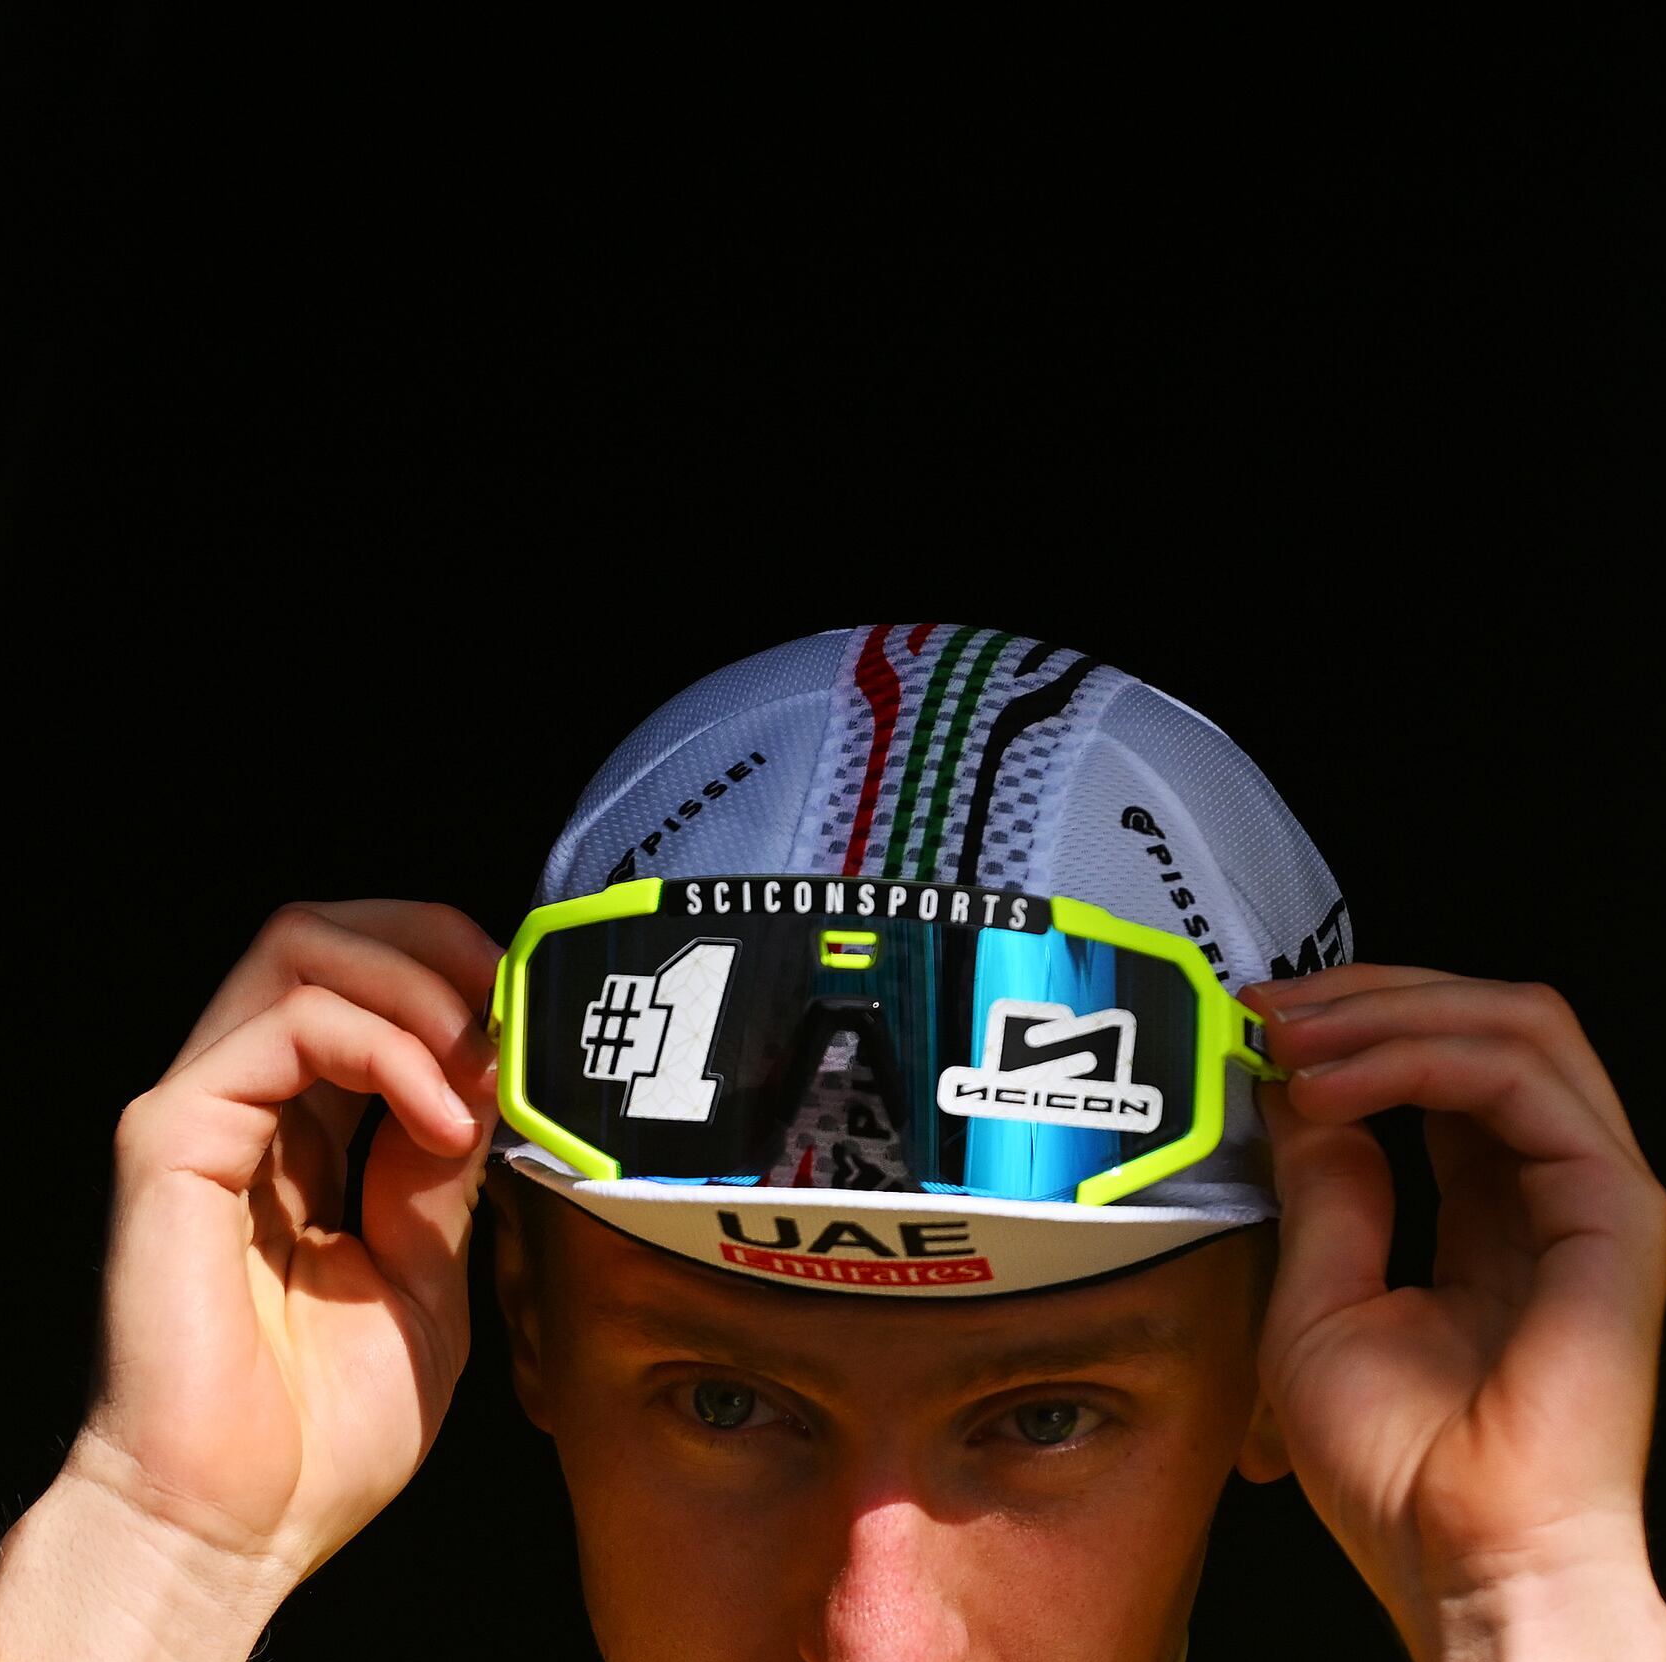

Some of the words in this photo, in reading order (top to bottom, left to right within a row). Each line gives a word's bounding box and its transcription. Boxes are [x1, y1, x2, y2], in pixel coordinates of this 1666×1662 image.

[640, 751, 767, 857] PISSEI
[685, 880, 1029, 930] SCICONSPORTS
[583, 941, 739, 1124] #1
[716, 1209, 976, 1258] UAE
[731, 1240, 985, 1283] Emirates
